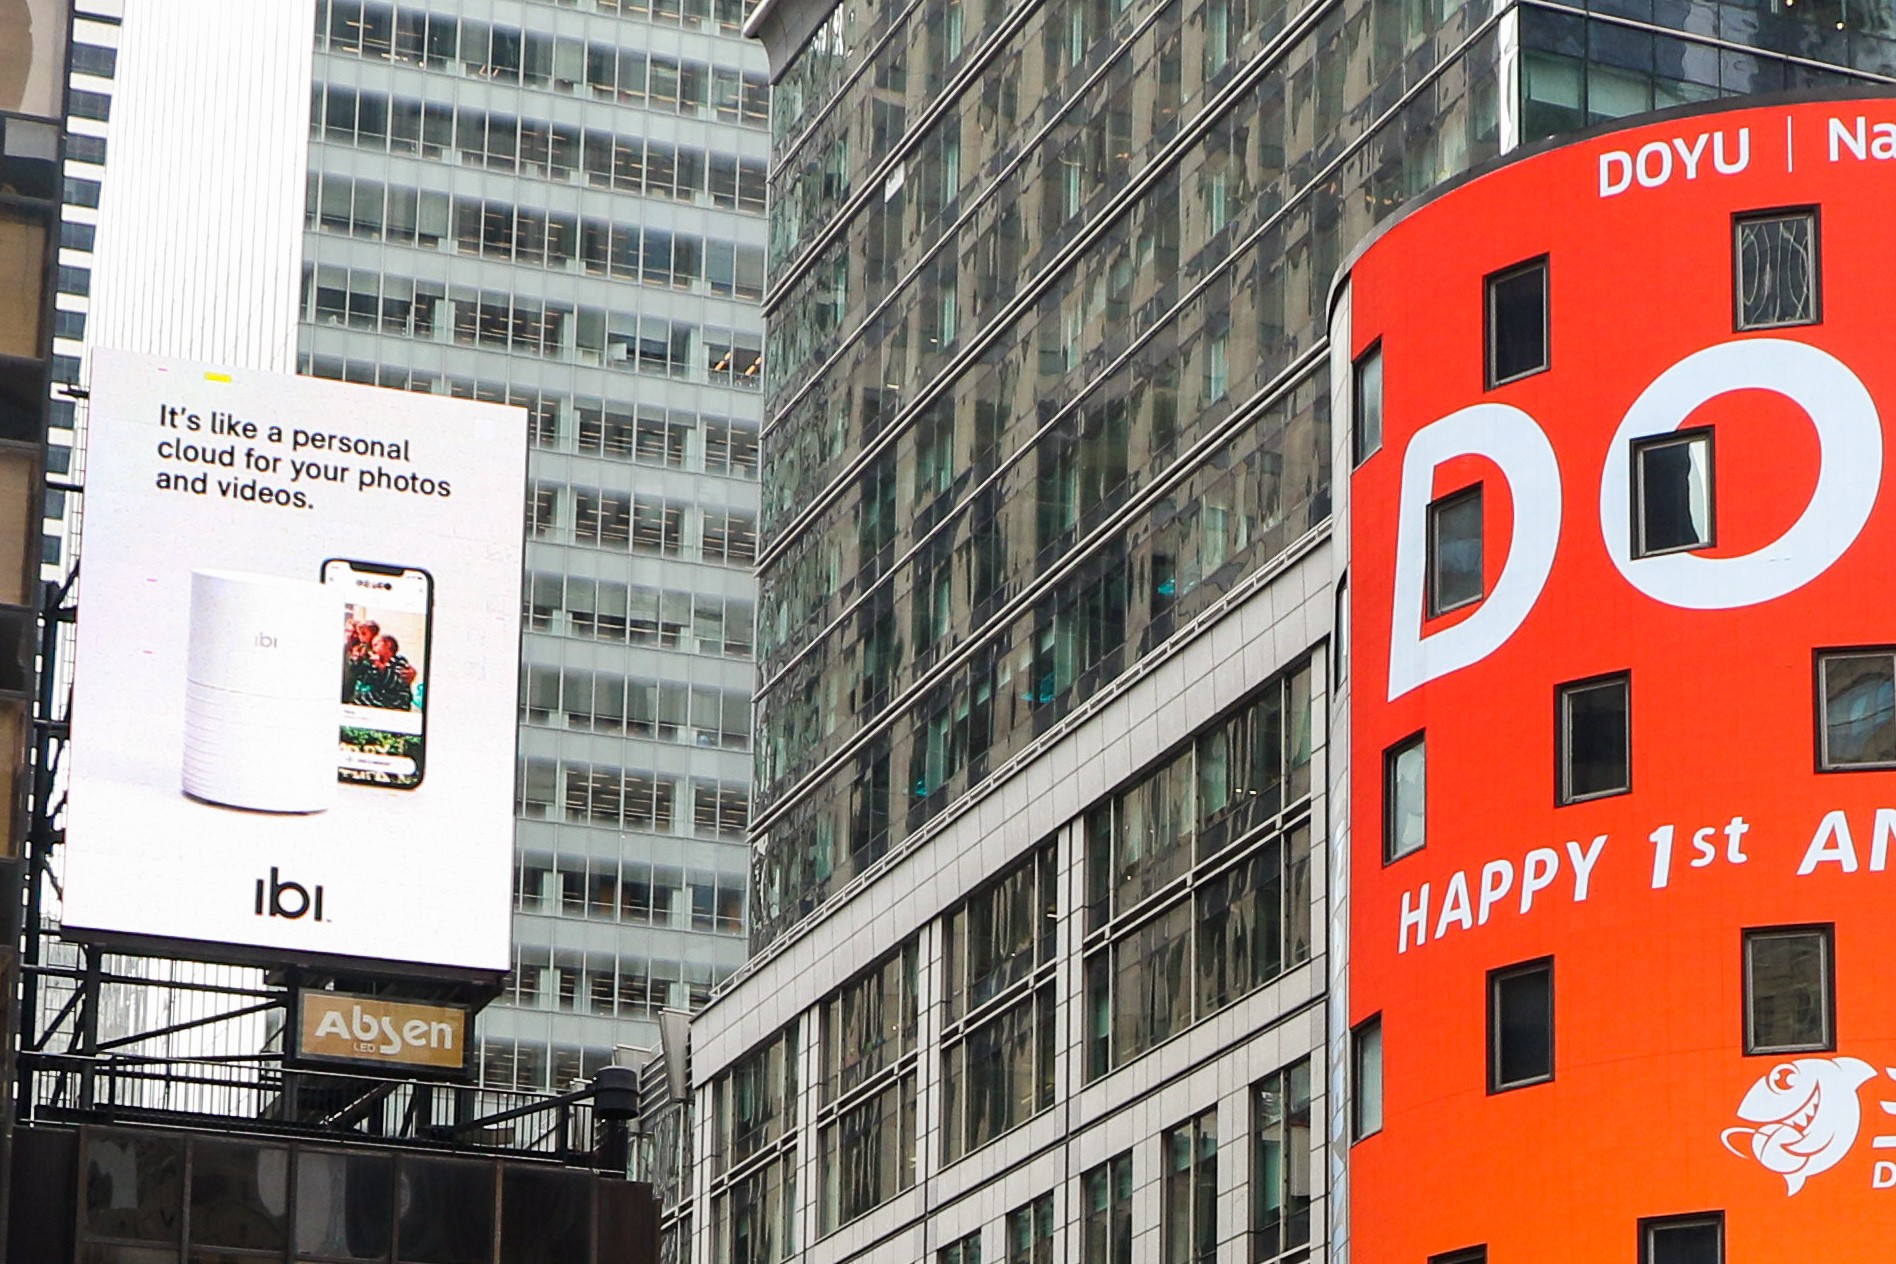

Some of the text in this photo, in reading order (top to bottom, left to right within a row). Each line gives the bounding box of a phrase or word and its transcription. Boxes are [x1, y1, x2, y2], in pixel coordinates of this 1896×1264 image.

[1599, 126, 1750, 198] DOYU
[160, 403, 411, 462] It's like a personal
[155, 472, 314, 510] and videos.
[157, 437, 451, 498] cloud for your photos
[1393, 833, 1609, 954] HAPPY
[1649, 815, 1751, 889] 1st
[315, 1005, 453, 1056] Absen
[354, 1042, 376, 1053] LED
